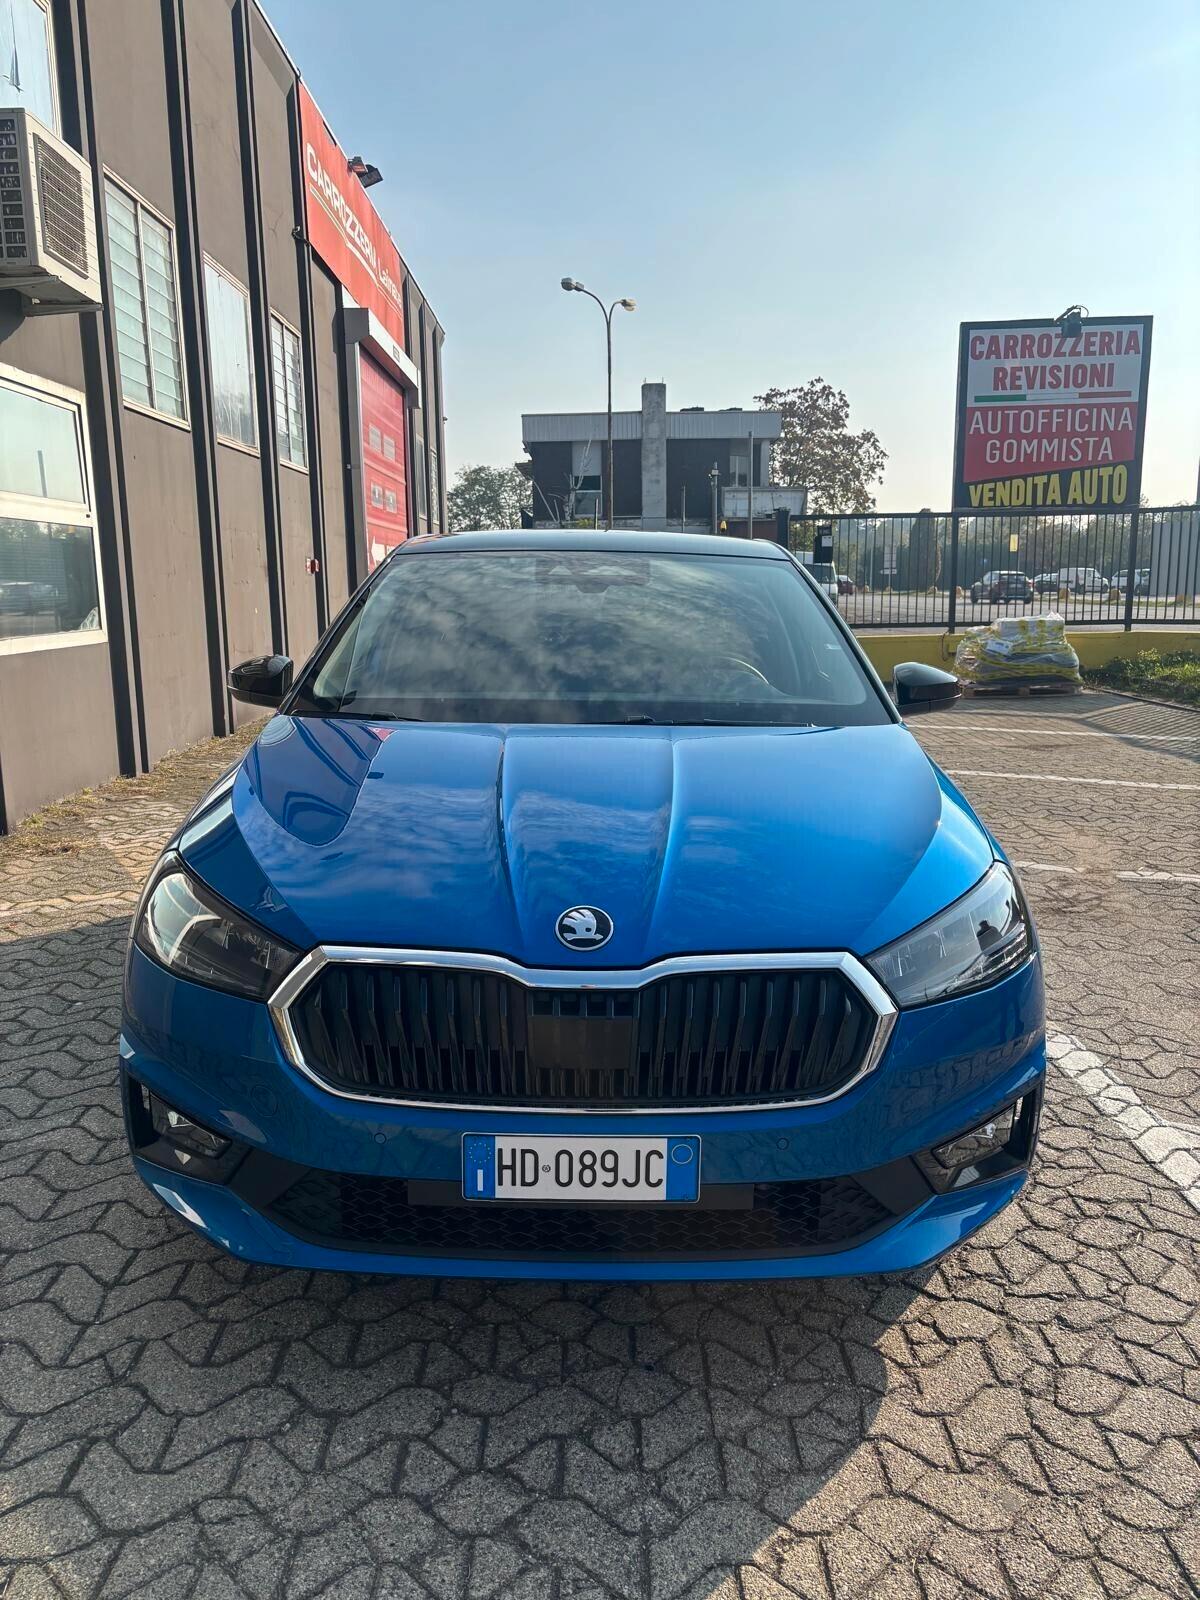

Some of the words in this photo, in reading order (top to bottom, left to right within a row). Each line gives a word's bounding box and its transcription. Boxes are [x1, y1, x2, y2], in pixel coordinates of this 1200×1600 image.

[306, 143, 377, 269] CARROZZERIA
[970, 330, 1141, 361] CARROZZERIA
[993, 363, 1115, 392] REVISIONI
[969, 407, 1133, 435] AUTOFFICINA
[985, 437, 1113, 464] GOMMISTA
[969, 473, 1061, 507] VENDITA
[1068, 464, 1128, 505] AUTO
